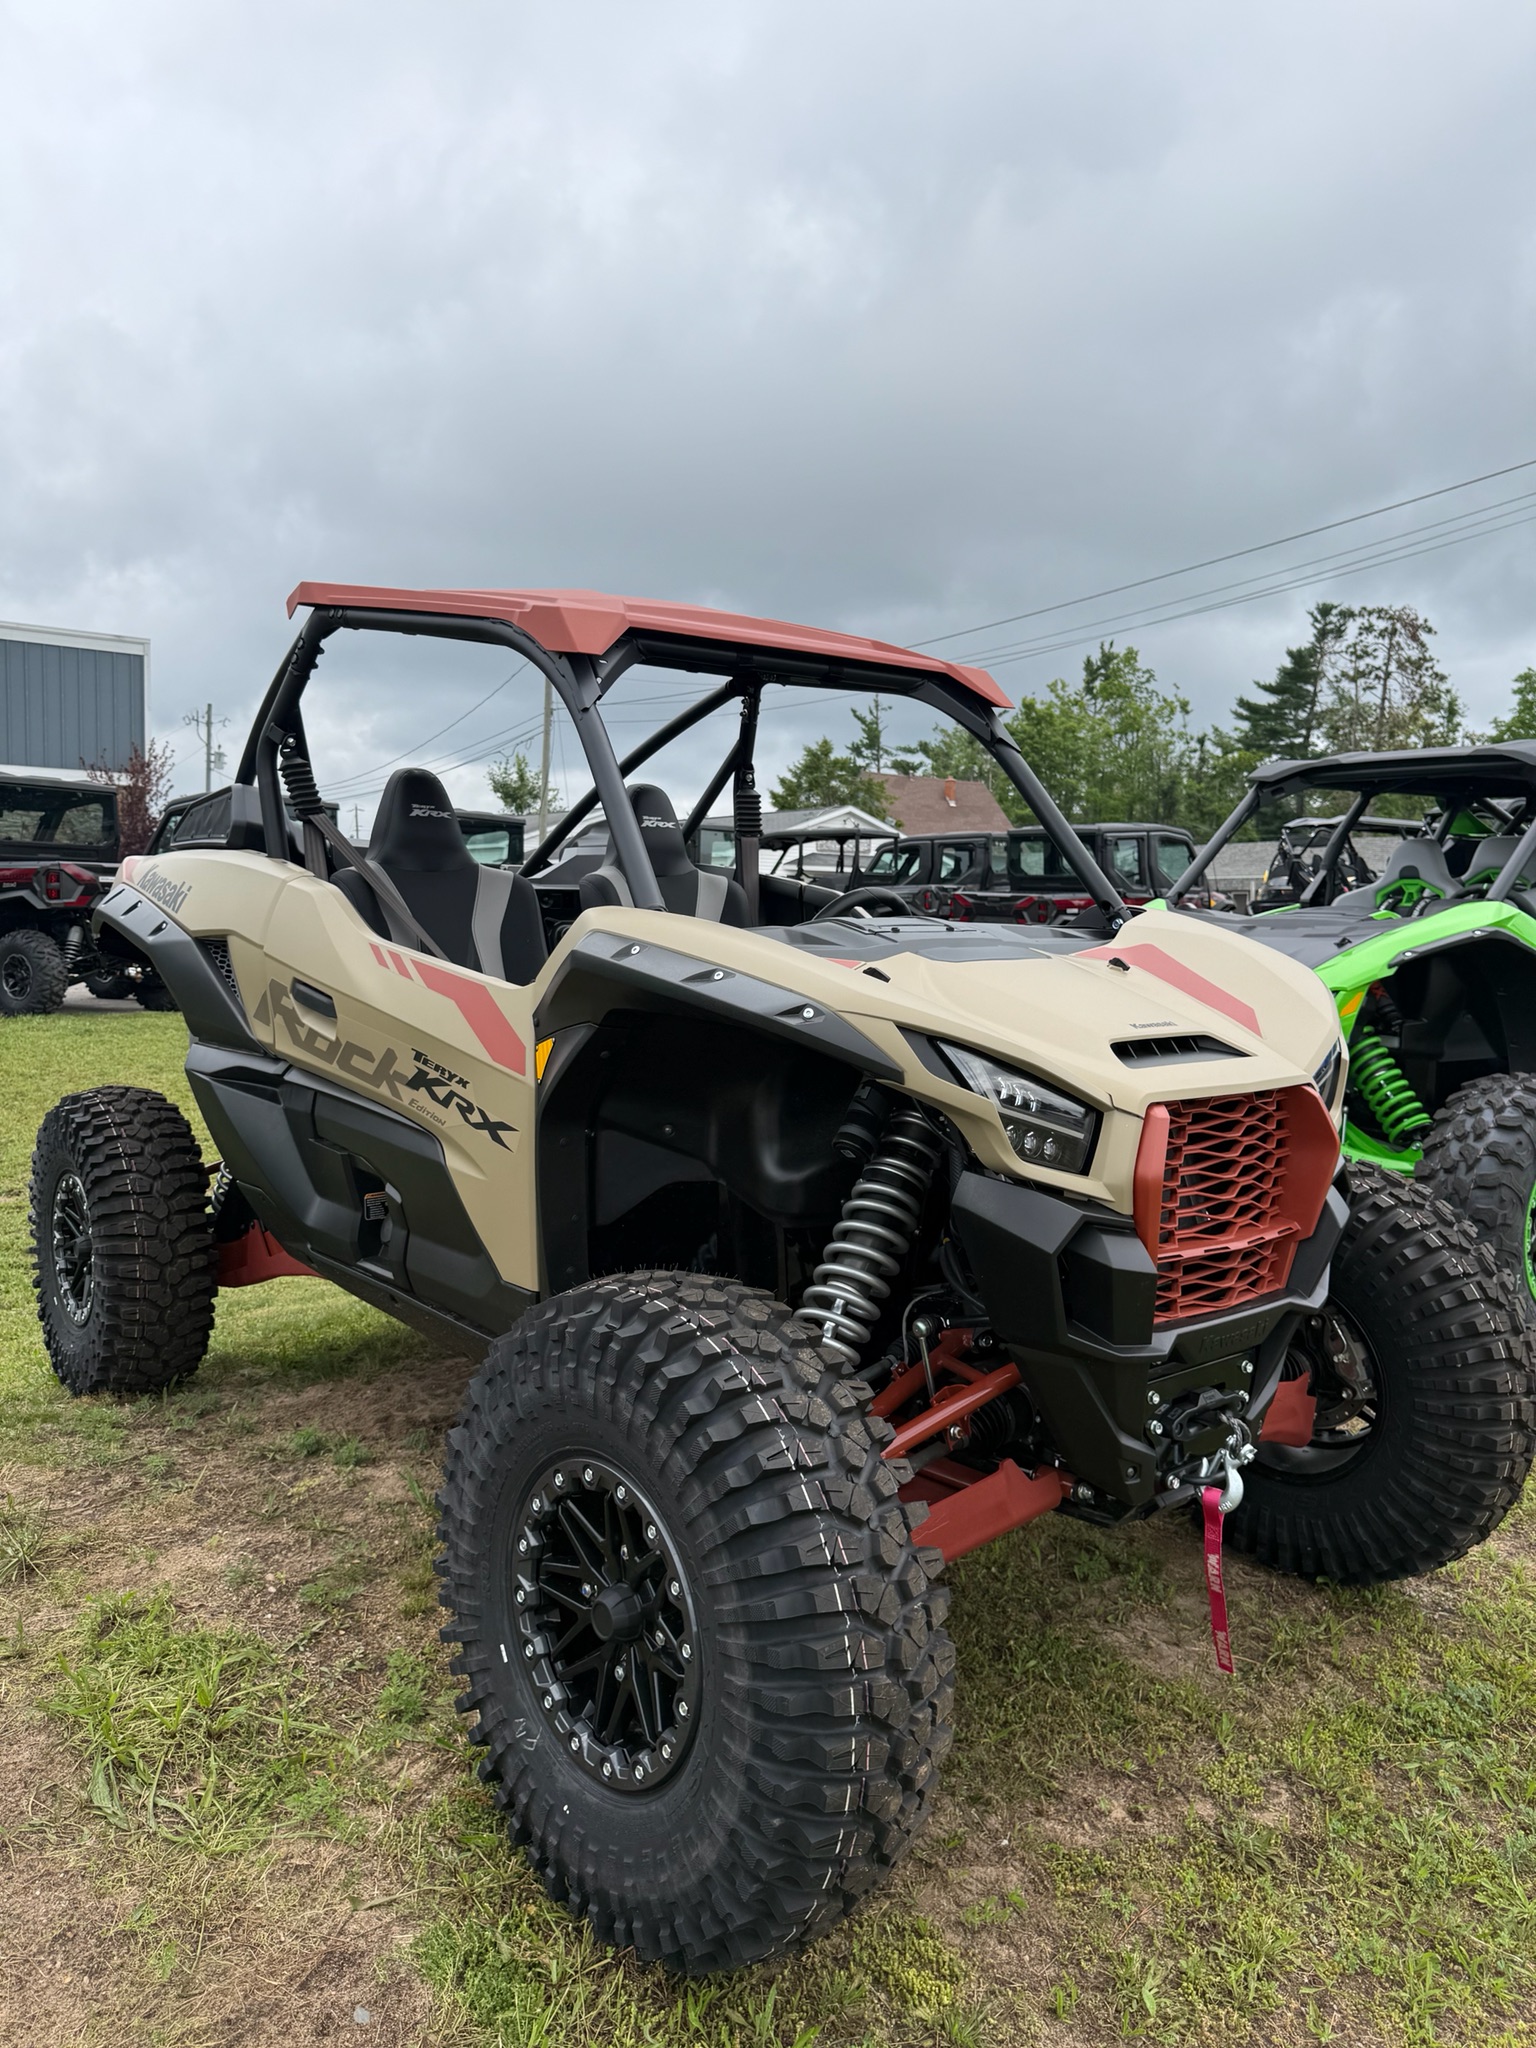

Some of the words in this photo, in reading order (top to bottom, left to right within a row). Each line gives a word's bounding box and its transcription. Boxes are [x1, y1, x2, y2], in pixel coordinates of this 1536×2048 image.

[409, 808, 452, 820] KRX
[640, 819, 676, 829] KRX
[137, 863, 193, 915] Kawasaki
[405, 1065, 520, 1154] KRX
[1199, 1317, 1270, 1355] Kawasaki
[1207, 1553, 1223, 1594] WARN
[1215, 1629, 1232, 1668] WARN
